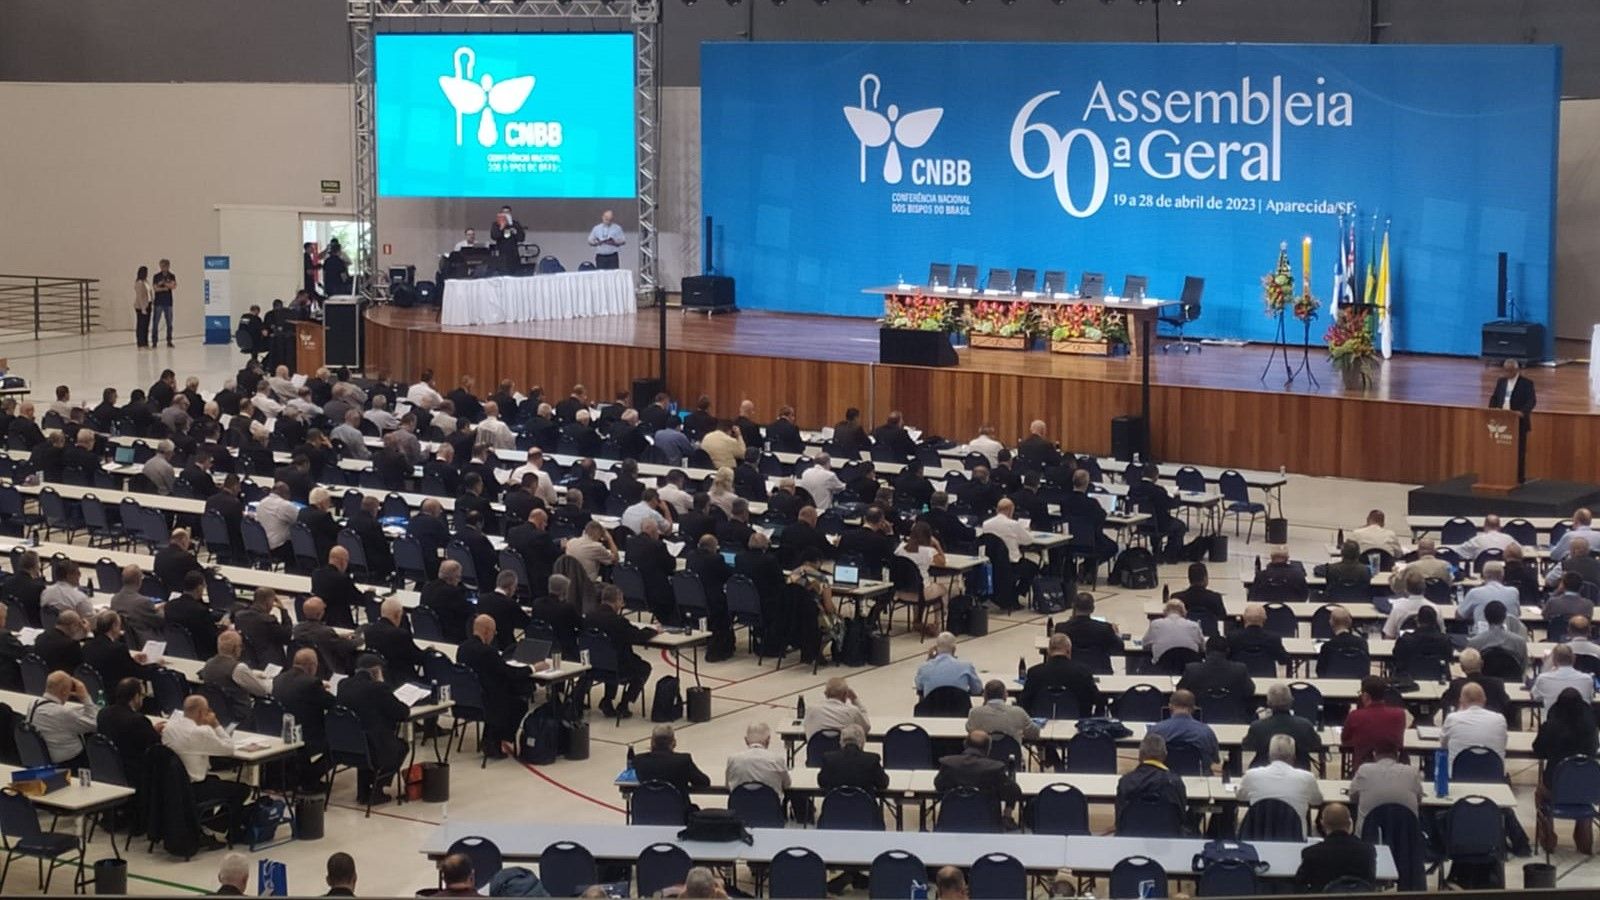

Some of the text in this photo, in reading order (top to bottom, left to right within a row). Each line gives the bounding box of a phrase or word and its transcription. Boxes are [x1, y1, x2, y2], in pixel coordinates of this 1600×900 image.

[1083, 75, 1354, 127] Assembleia
[504, 122, 563, 148] CNBB
[1138, 129, 1281, 182] Geral
[912, 158, 971, 186] CNBB
[1113, 194, 1127, 206] 19
[1129, 196, 1137, 206] a
[1139, 194, 1154, 207] 28
[1156, 194, 1172, 208] de
[1174, 195, 1203, 209] abril
[1206, 196, 1223, 210] de
[1225, 197, 1256, 211] 2023
